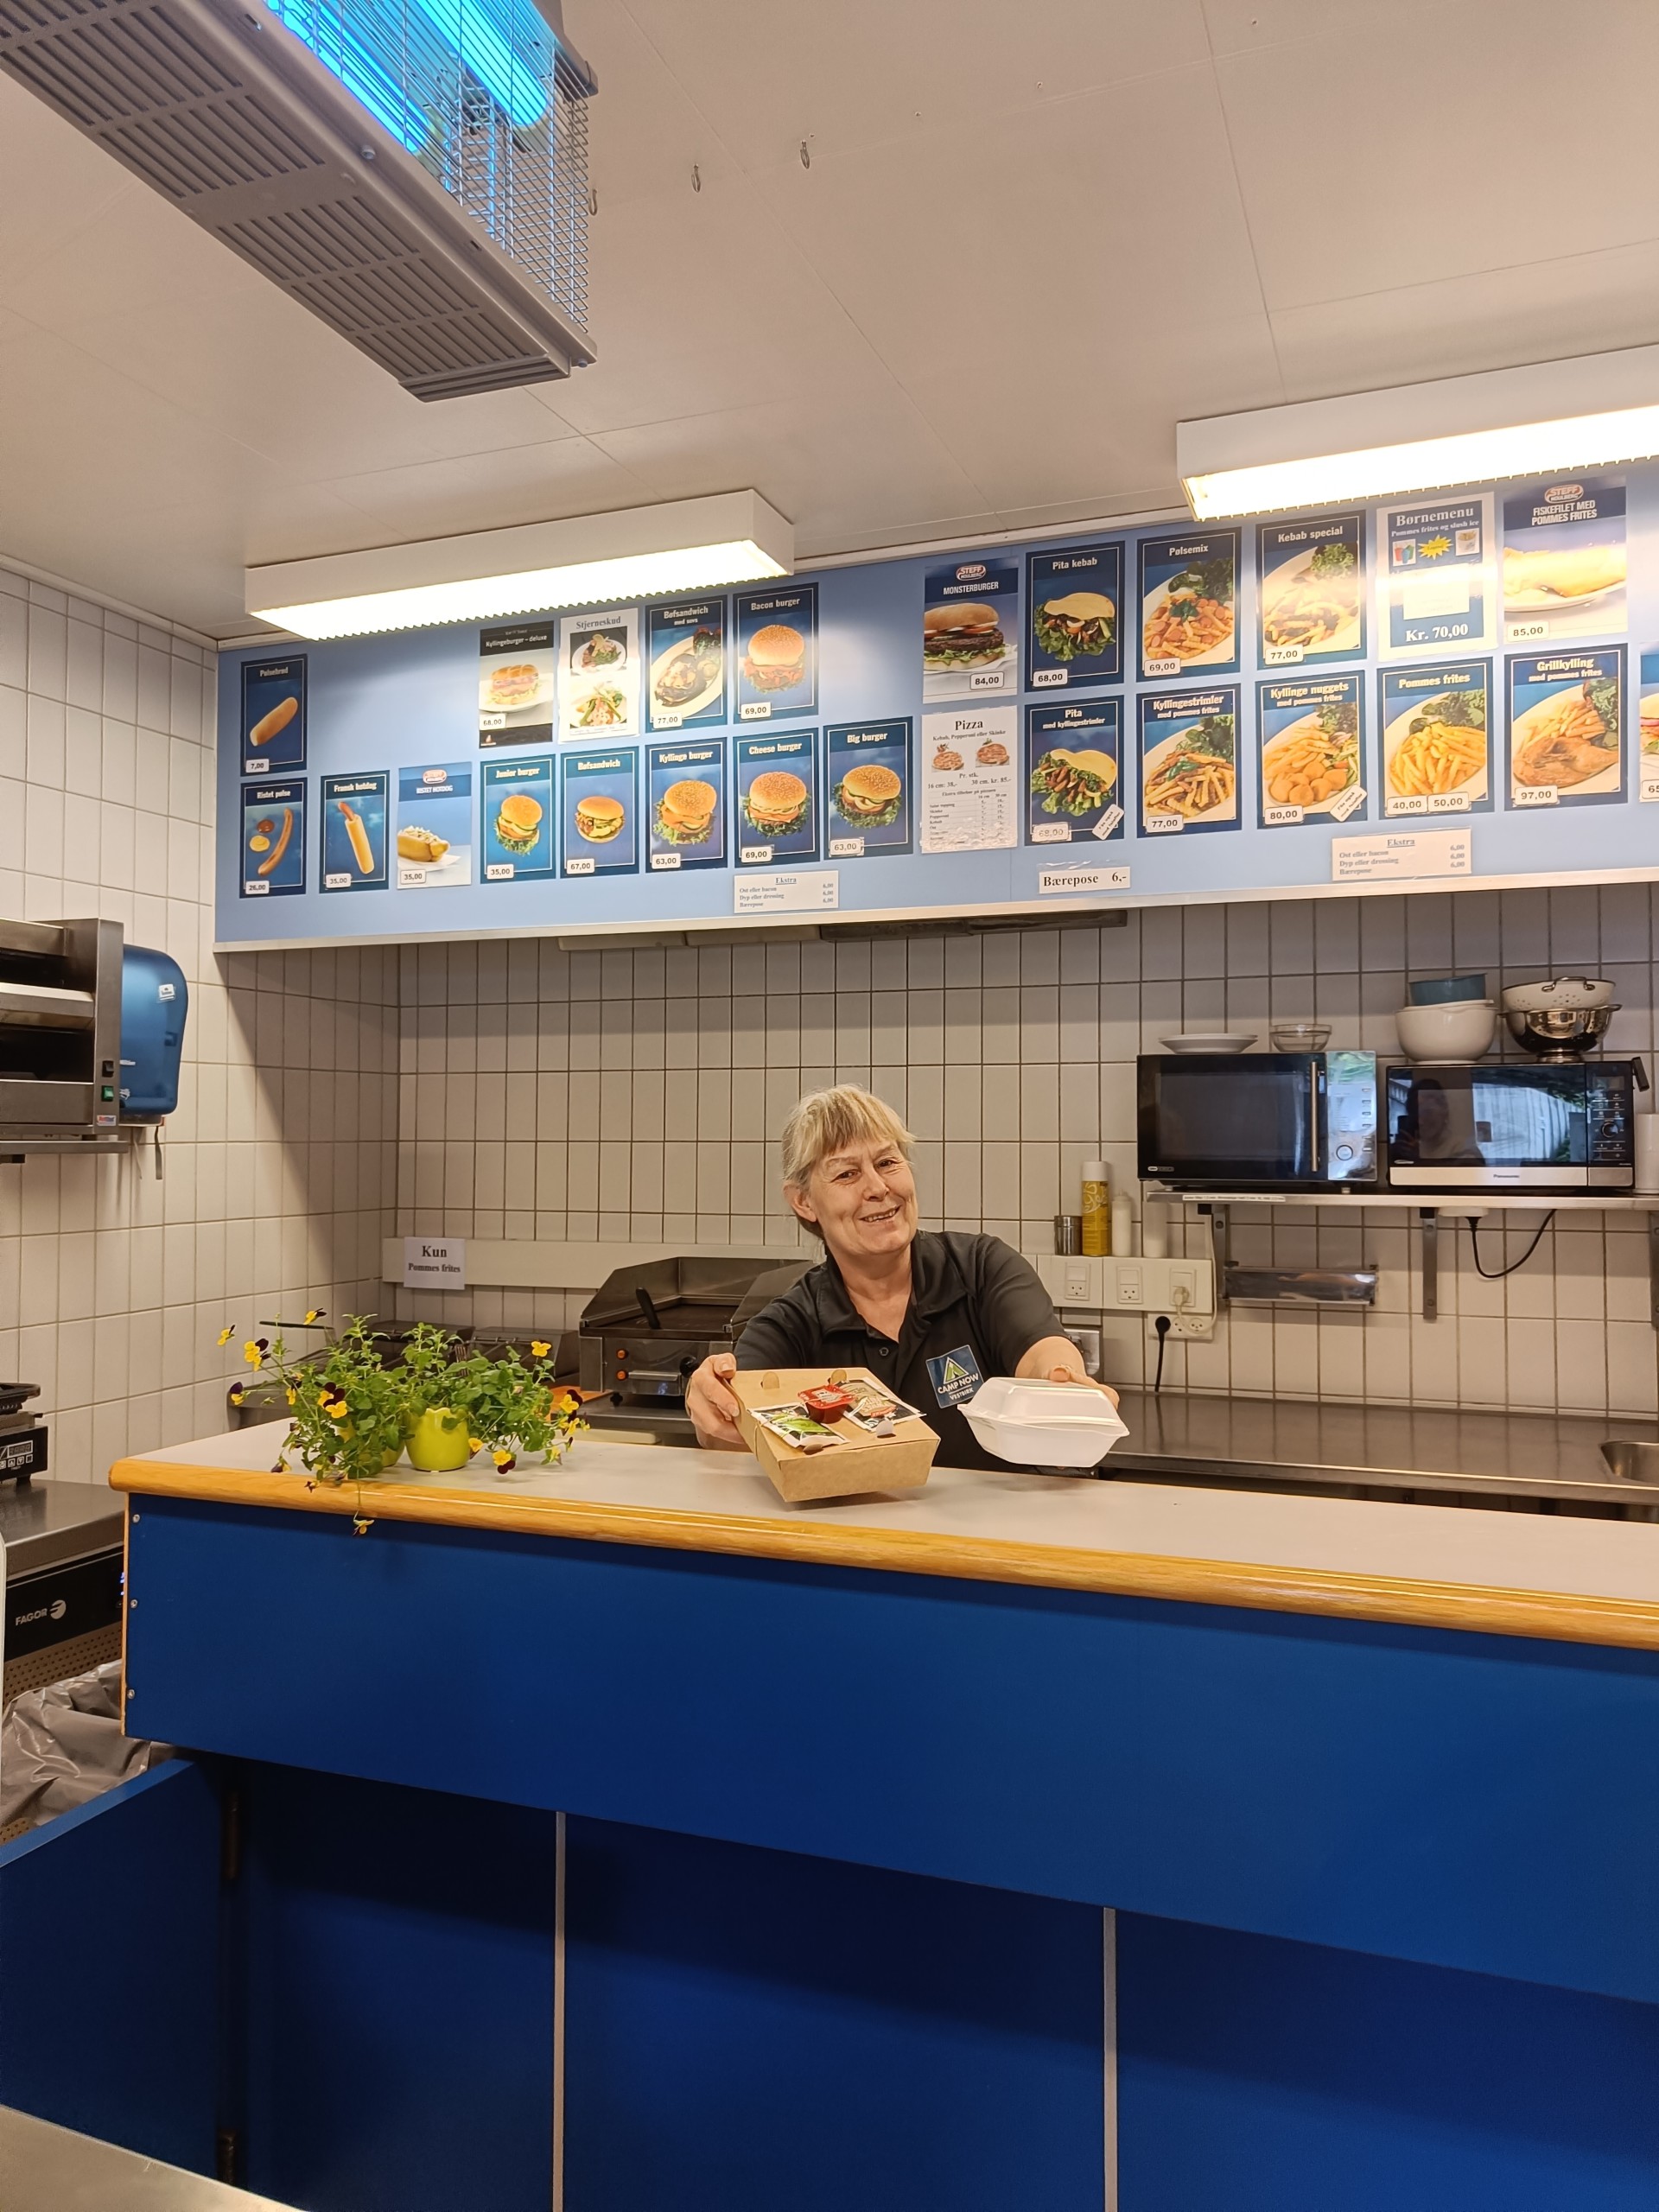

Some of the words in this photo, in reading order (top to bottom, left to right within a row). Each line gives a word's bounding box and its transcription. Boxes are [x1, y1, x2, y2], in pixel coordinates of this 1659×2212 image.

[1548, 486, 1579, 496] STEFF
[1533, 502, 1576, 517] FISKEFILET
[1576, 499, 1596, 511] MED
[1395, 507, 1474, 527] Børnemenu
[1531, 512, 1569, 526] POMMES
[1569, 508, 1598, 521] FRITES
[1278, 531, 1307, 543] Kebab
[1309, 525, 1344, 540] special
[1421, 524, 1440, 533] frites
[1169, 543, 1209, 556] Pølsemix
[1052, 560, 1070, 570] Pita
[1071, 556, 1098, 568] kebab
[959, 566, 983, 575] STEFF
[943, 581, 1000, 595] MONSTERBURGER
[750, 601, 773, 611] Bacon
[775, 598, 800, 608] burger
[664, 606, 709, 620] Bøfsandwich
[575, 615, 621, 631] Stjerneskud
[1405, 629, 1429, 643] Kr.
[1432, 623, 1469, 640] 70,00
[1513, 626, 1544, 637] 85,00
[486, 638, 524, 648] Kyllingeburger
[1270, 650, 1298, 660] 77,00
[1149, 662, 1176, 672] 69,00
[1536, 657, 1595, 672] Grillkylling
[975, 677, 1000, 686] 84,00
[1038, 673, 1064, 683] 68,00
[1398, 677, 1441, 690] Pommes
[1443, 673, 1471, 684] frites
[1529, 673, 1546, 683] med
[1580, 669, 1603, 678] frites
[1270, 687, 1308, 699] Kyllinge
[1311, 683, 1350, 695] nuggets
[1153, 695, 1224, 711] Kyllingestrimler
[745, 706, 767, 715] 69,00
[1065, 709, 1083, 719] Pita
[1173, 709, 1201, 719] pommes
[1201, 707, 1220, 715] frites
[954, 720, 984, 731] Pizza
[1042, 721, 1057, 729] med
[1057, 717, 1106, 729] kyllingestrimler
[847, 733, 861, 744] Big
[861, 731, 888, 742] burger
[748, 746, 776, 755] Cheese
[777, 742, 803, 752] burger
[658, 753, 688, 763] Kyllinge
[689, 750, 714, 760] burger
[496, 768, 517, 779] Junior
[517, 766, 541, 777] burger
[1521, 790, 1552, 800] 97,00
[1393, 799, 1422, 810] 40,00
[1433, 797, 1464, 808] 50,00
[1269, 810, 1298, 820] 80,00
[1151, 818, 1179, 829] 77,00
[834, 842, 857, 851] 63,00
[1387, 838, 1415, 849] Ekstra
[745, 850, 768, 860] 69,00
[570, 862, 591, 871] 67,00
[655, 857, 677, 866] 63,00
[1043, 874, 1099, 887] Bærepose
[1111, 872, 1127, 883] 6,-
[422, 1245, 448, 1258] Kun
[408, 1262, 440, 1273] Pommes
[442, 1263, 461, 1274] frites
[938, 1382, 959, 1394] CAMP
[959, 1372, 979, 1387] NOW
[949, 1387, 975, 1401] VESTBIRK
[15, 1608, 48, 1626] FAGOR
